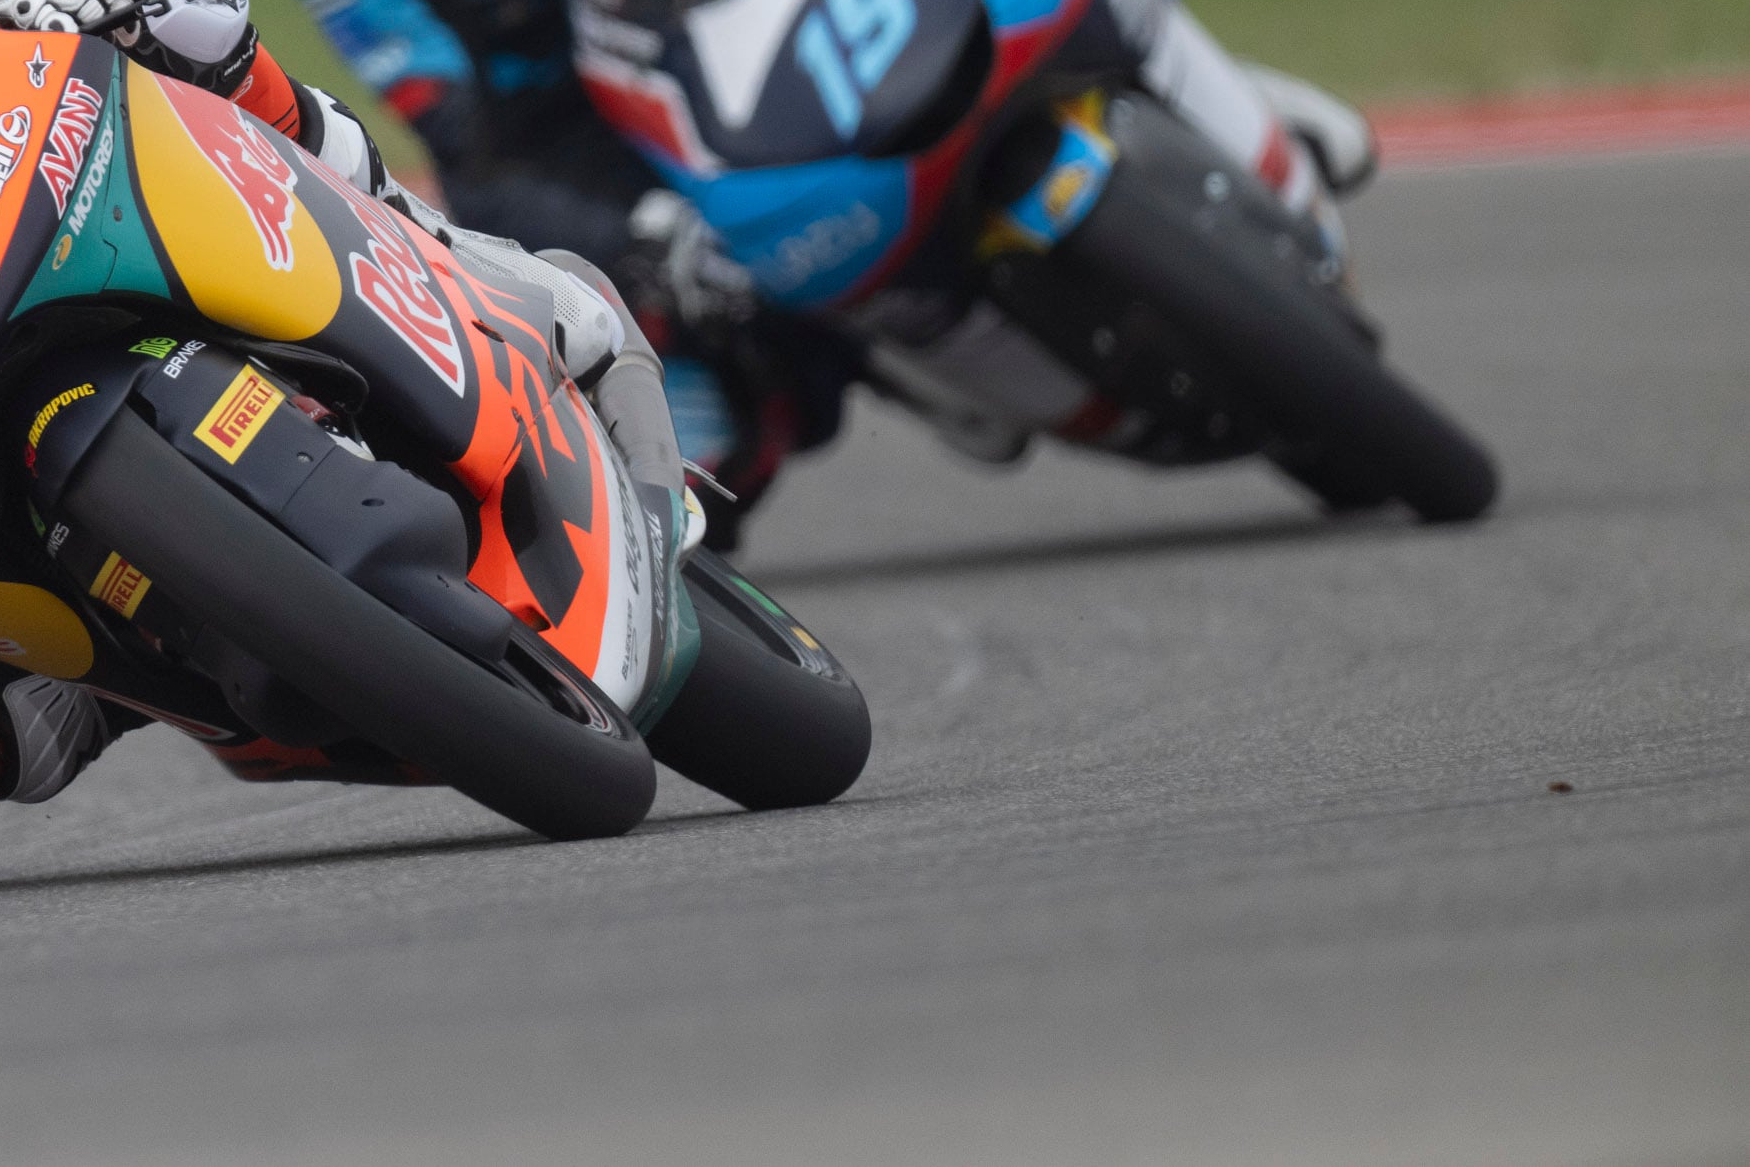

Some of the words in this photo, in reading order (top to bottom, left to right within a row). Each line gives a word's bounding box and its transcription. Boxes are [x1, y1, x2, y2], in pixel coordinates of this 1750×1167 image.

[39, 78, 103, 221] AVANT
[68, 119, 114, 236] MOTOREX
[162, 338, 207, 380] BRAKES
[208, 374, 275, 449] PIRELLI
